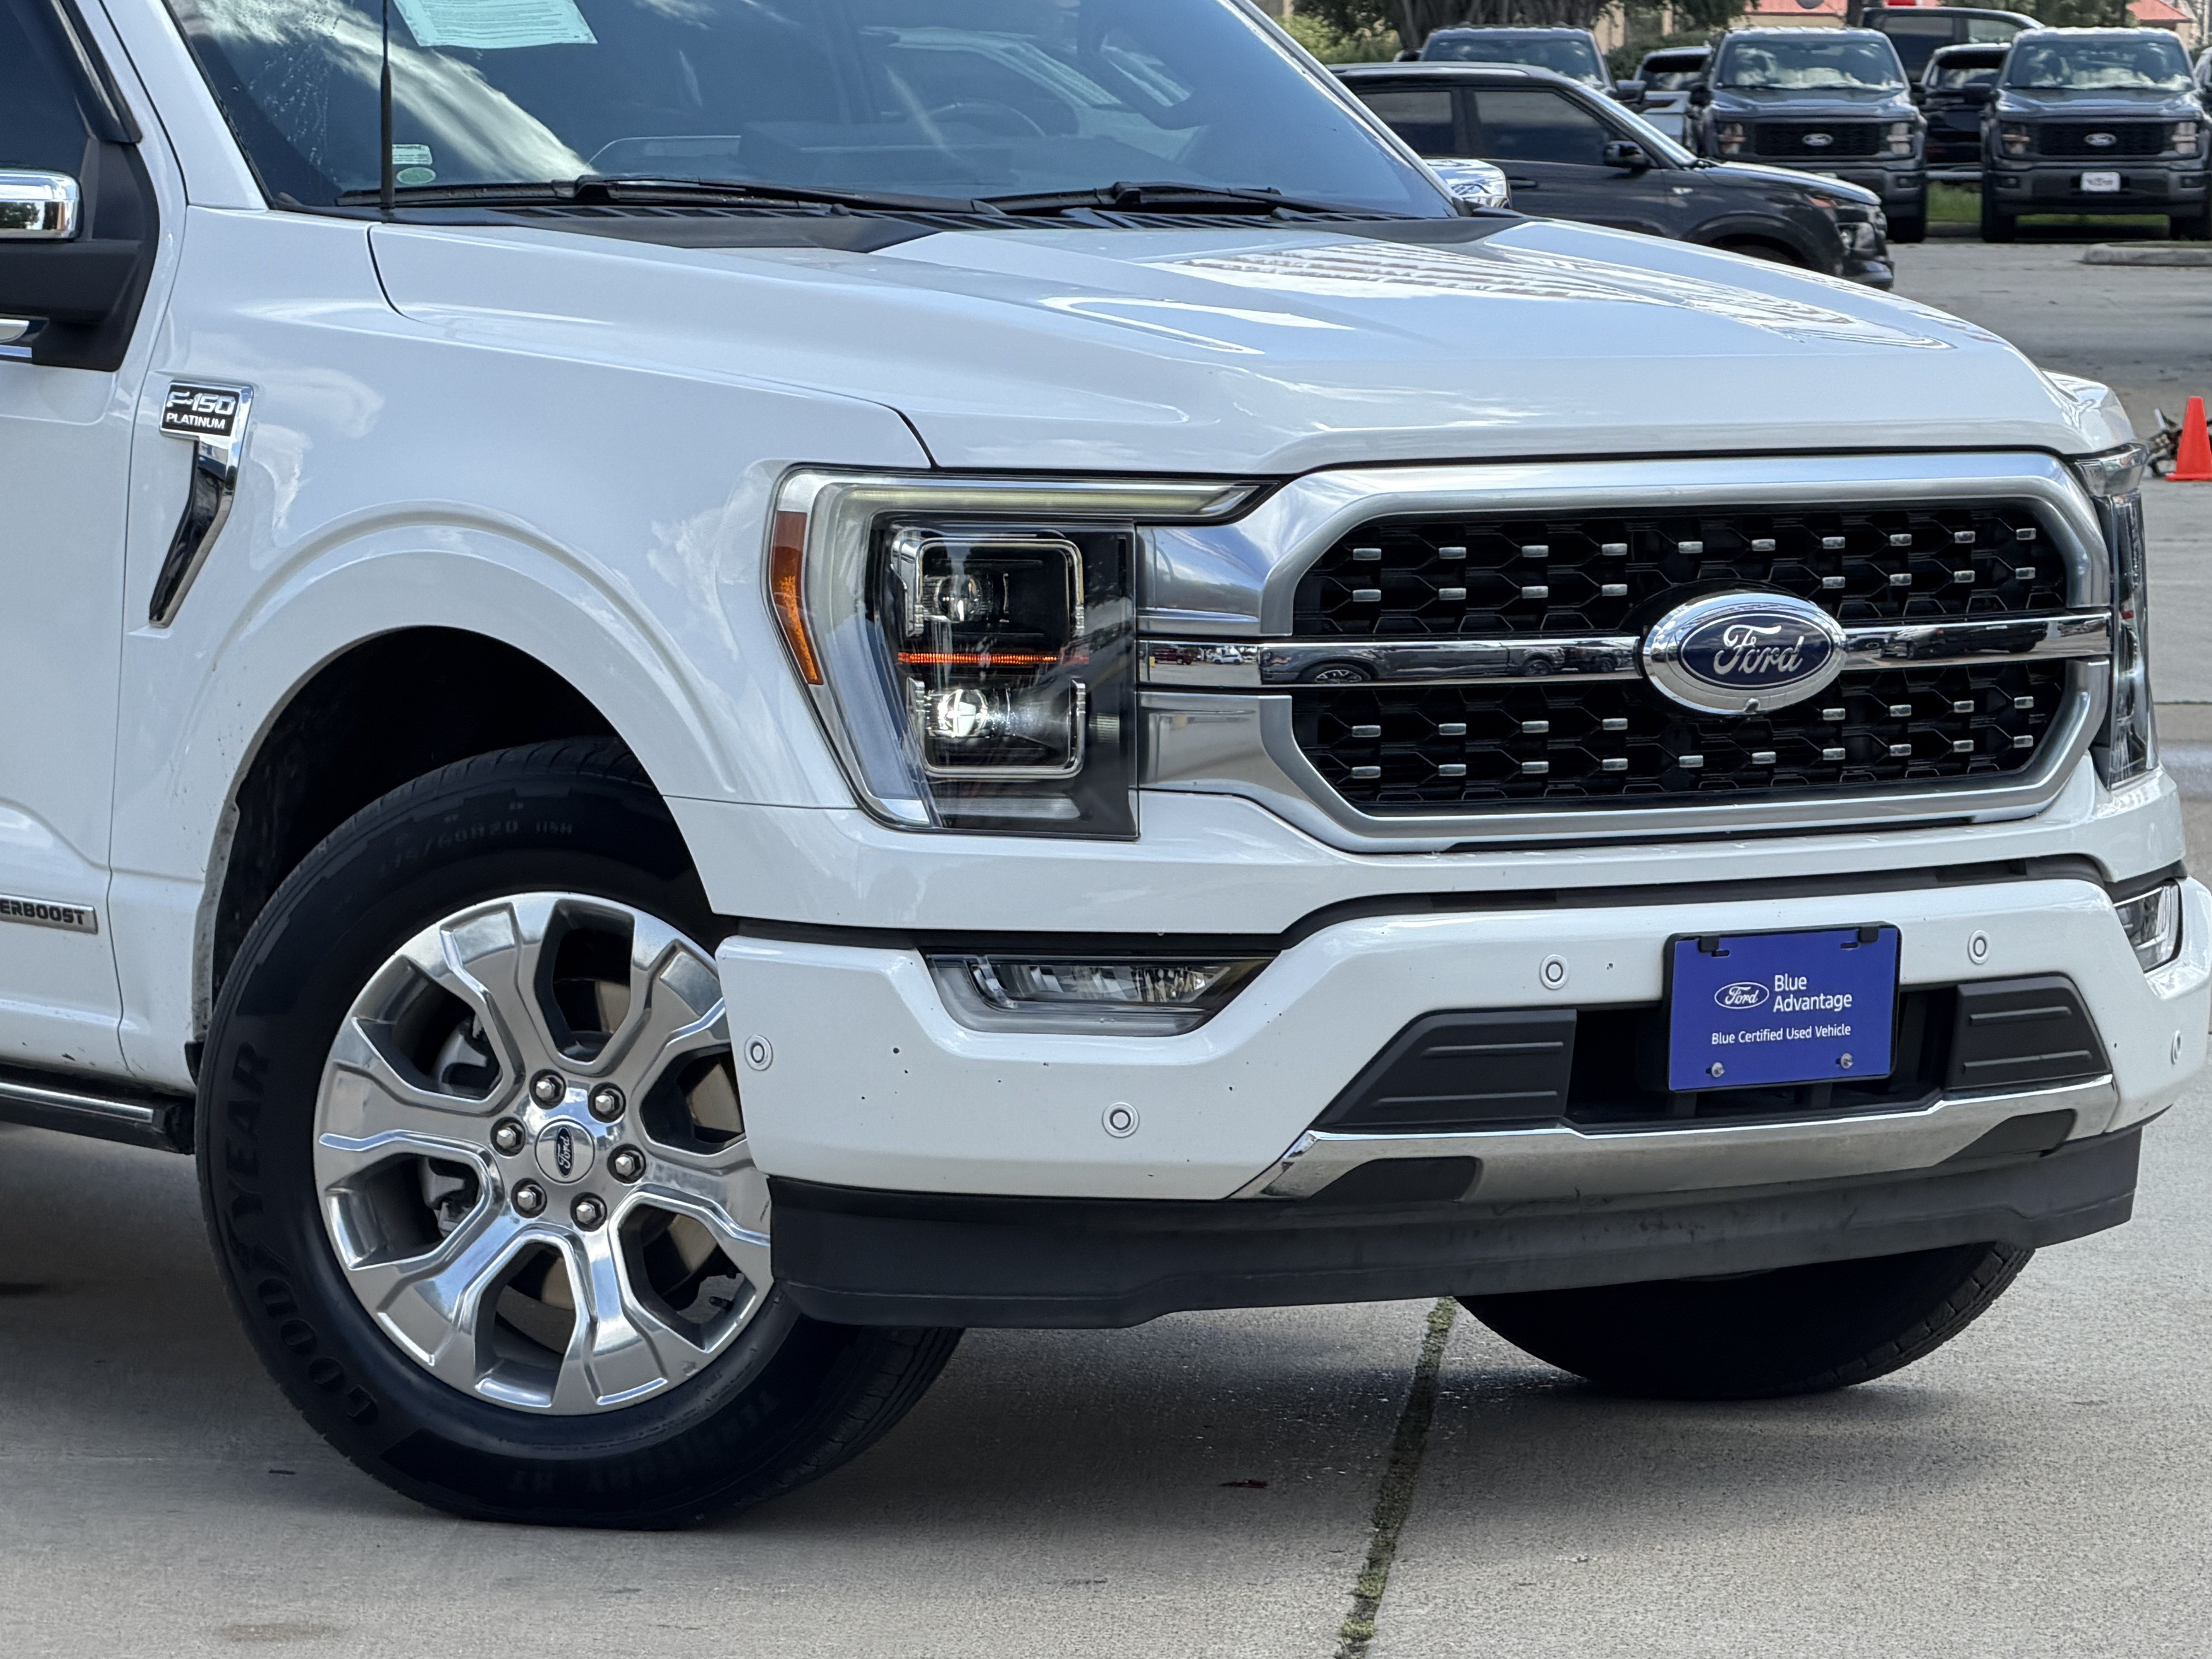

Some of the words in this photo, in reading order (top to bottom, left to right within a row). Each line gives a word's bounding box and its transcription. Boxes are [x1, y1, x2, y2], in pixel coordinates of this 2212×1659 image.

[166, 391, 236, 415] F-150
[166, 412, 226, 429] PLATINUM
[1713, 624, 1805, 675] Ford
[0, 899, 84, 925] ERBOOST
[1774, 973, 1807, 992] Blue
[1725, 986, 1759, 1005] Ford
[1772, 993, 1853, 1013] Advantage
[1711, 1032, 1735, 1045] Blue
[1738, 1027, 1783, 1043] Certified
[1786, 1025, 1812, 1040] Used
[1815, 1023, 1851, 1037] Vehicle
[557, 1135, 571, 1169] Ford
